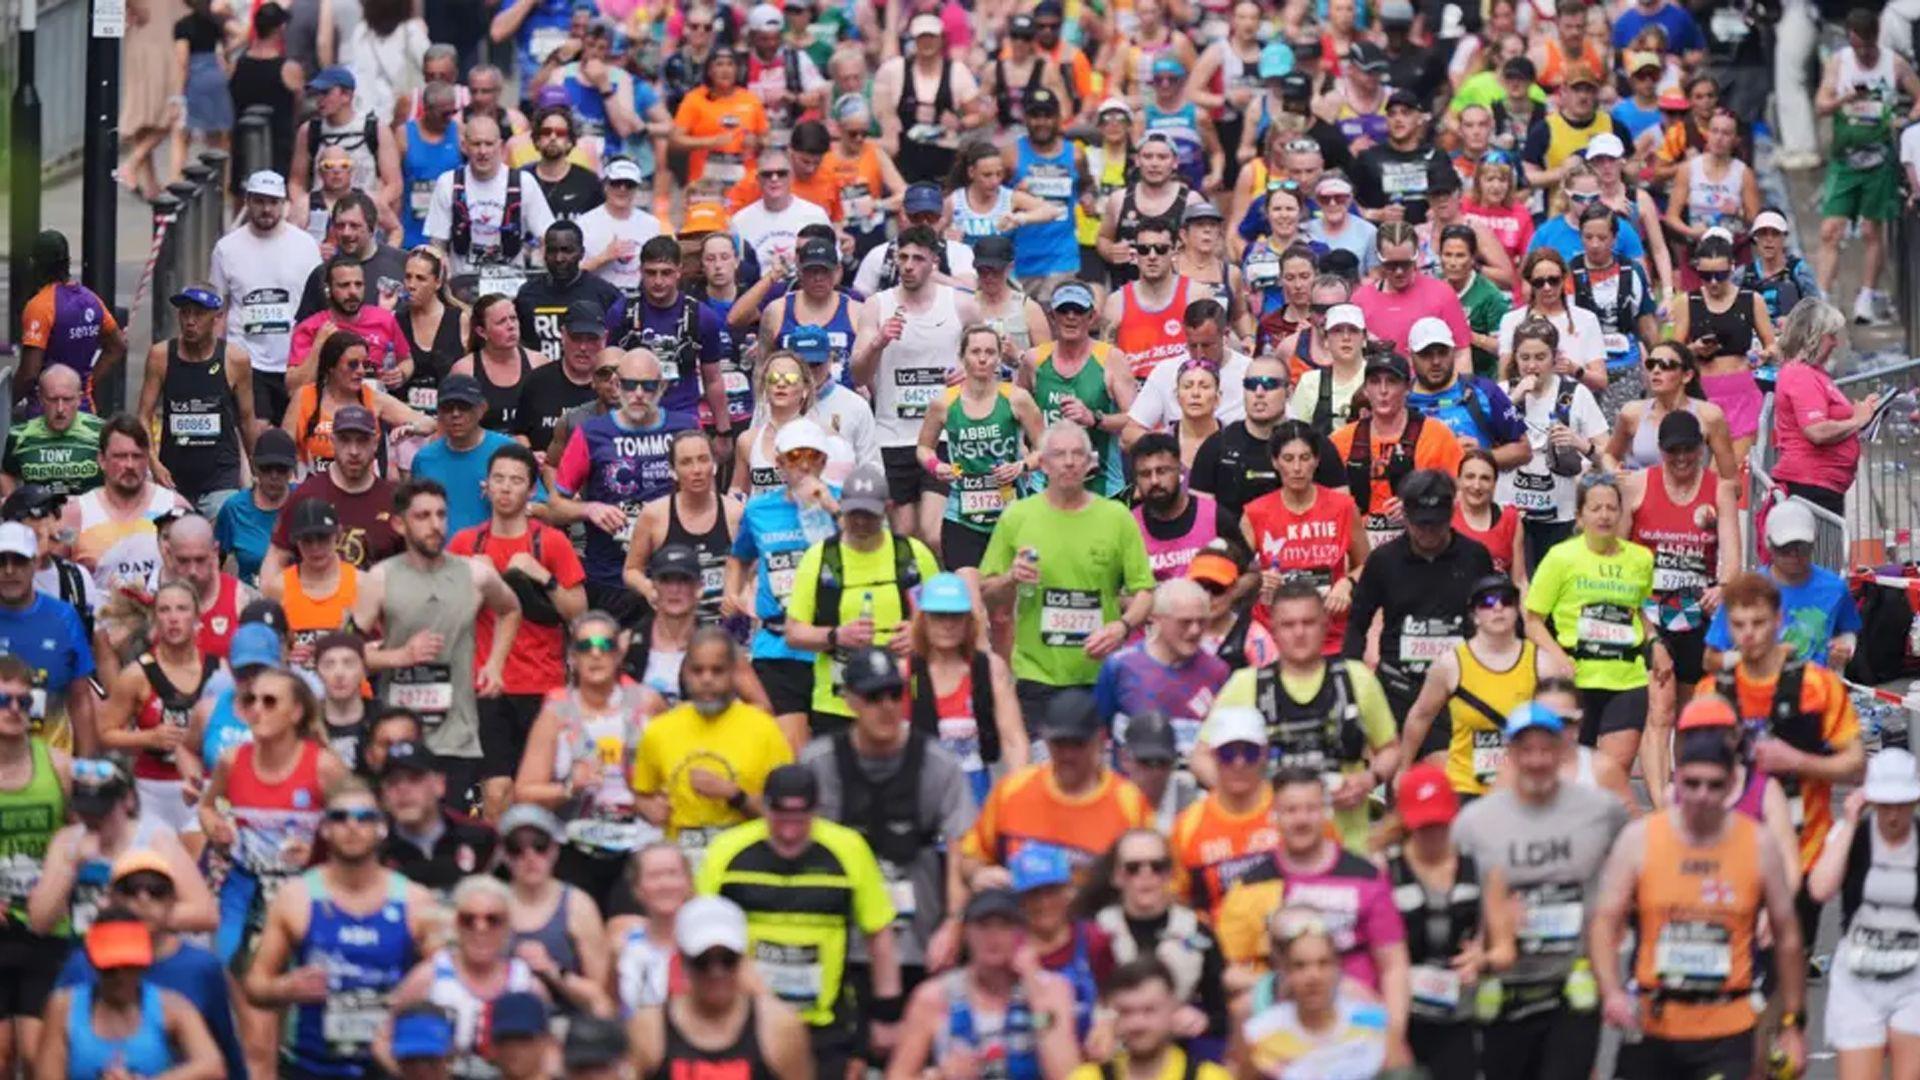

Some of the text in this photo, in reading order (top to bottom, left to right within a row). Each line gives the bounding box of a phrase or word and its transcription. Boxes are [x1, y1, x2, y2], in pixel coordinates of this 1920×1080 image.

[959, 424, 1001, 440] ABBIE
[40, 449, 72, 462] TONY
[951, 436, 1015, 459] NSPCC
[969, 494, 1008, 510] 3173
[1287, 521, 1337, 541] KATIE
[118, 559, 155, 574] DAN
[1597, 564, 1623, 578] LIZ
[1047, 590, 1070, 606] tcs
[1404, 615, 1428, 635] tcs
[1508, 837, 1572, 867] LDN
